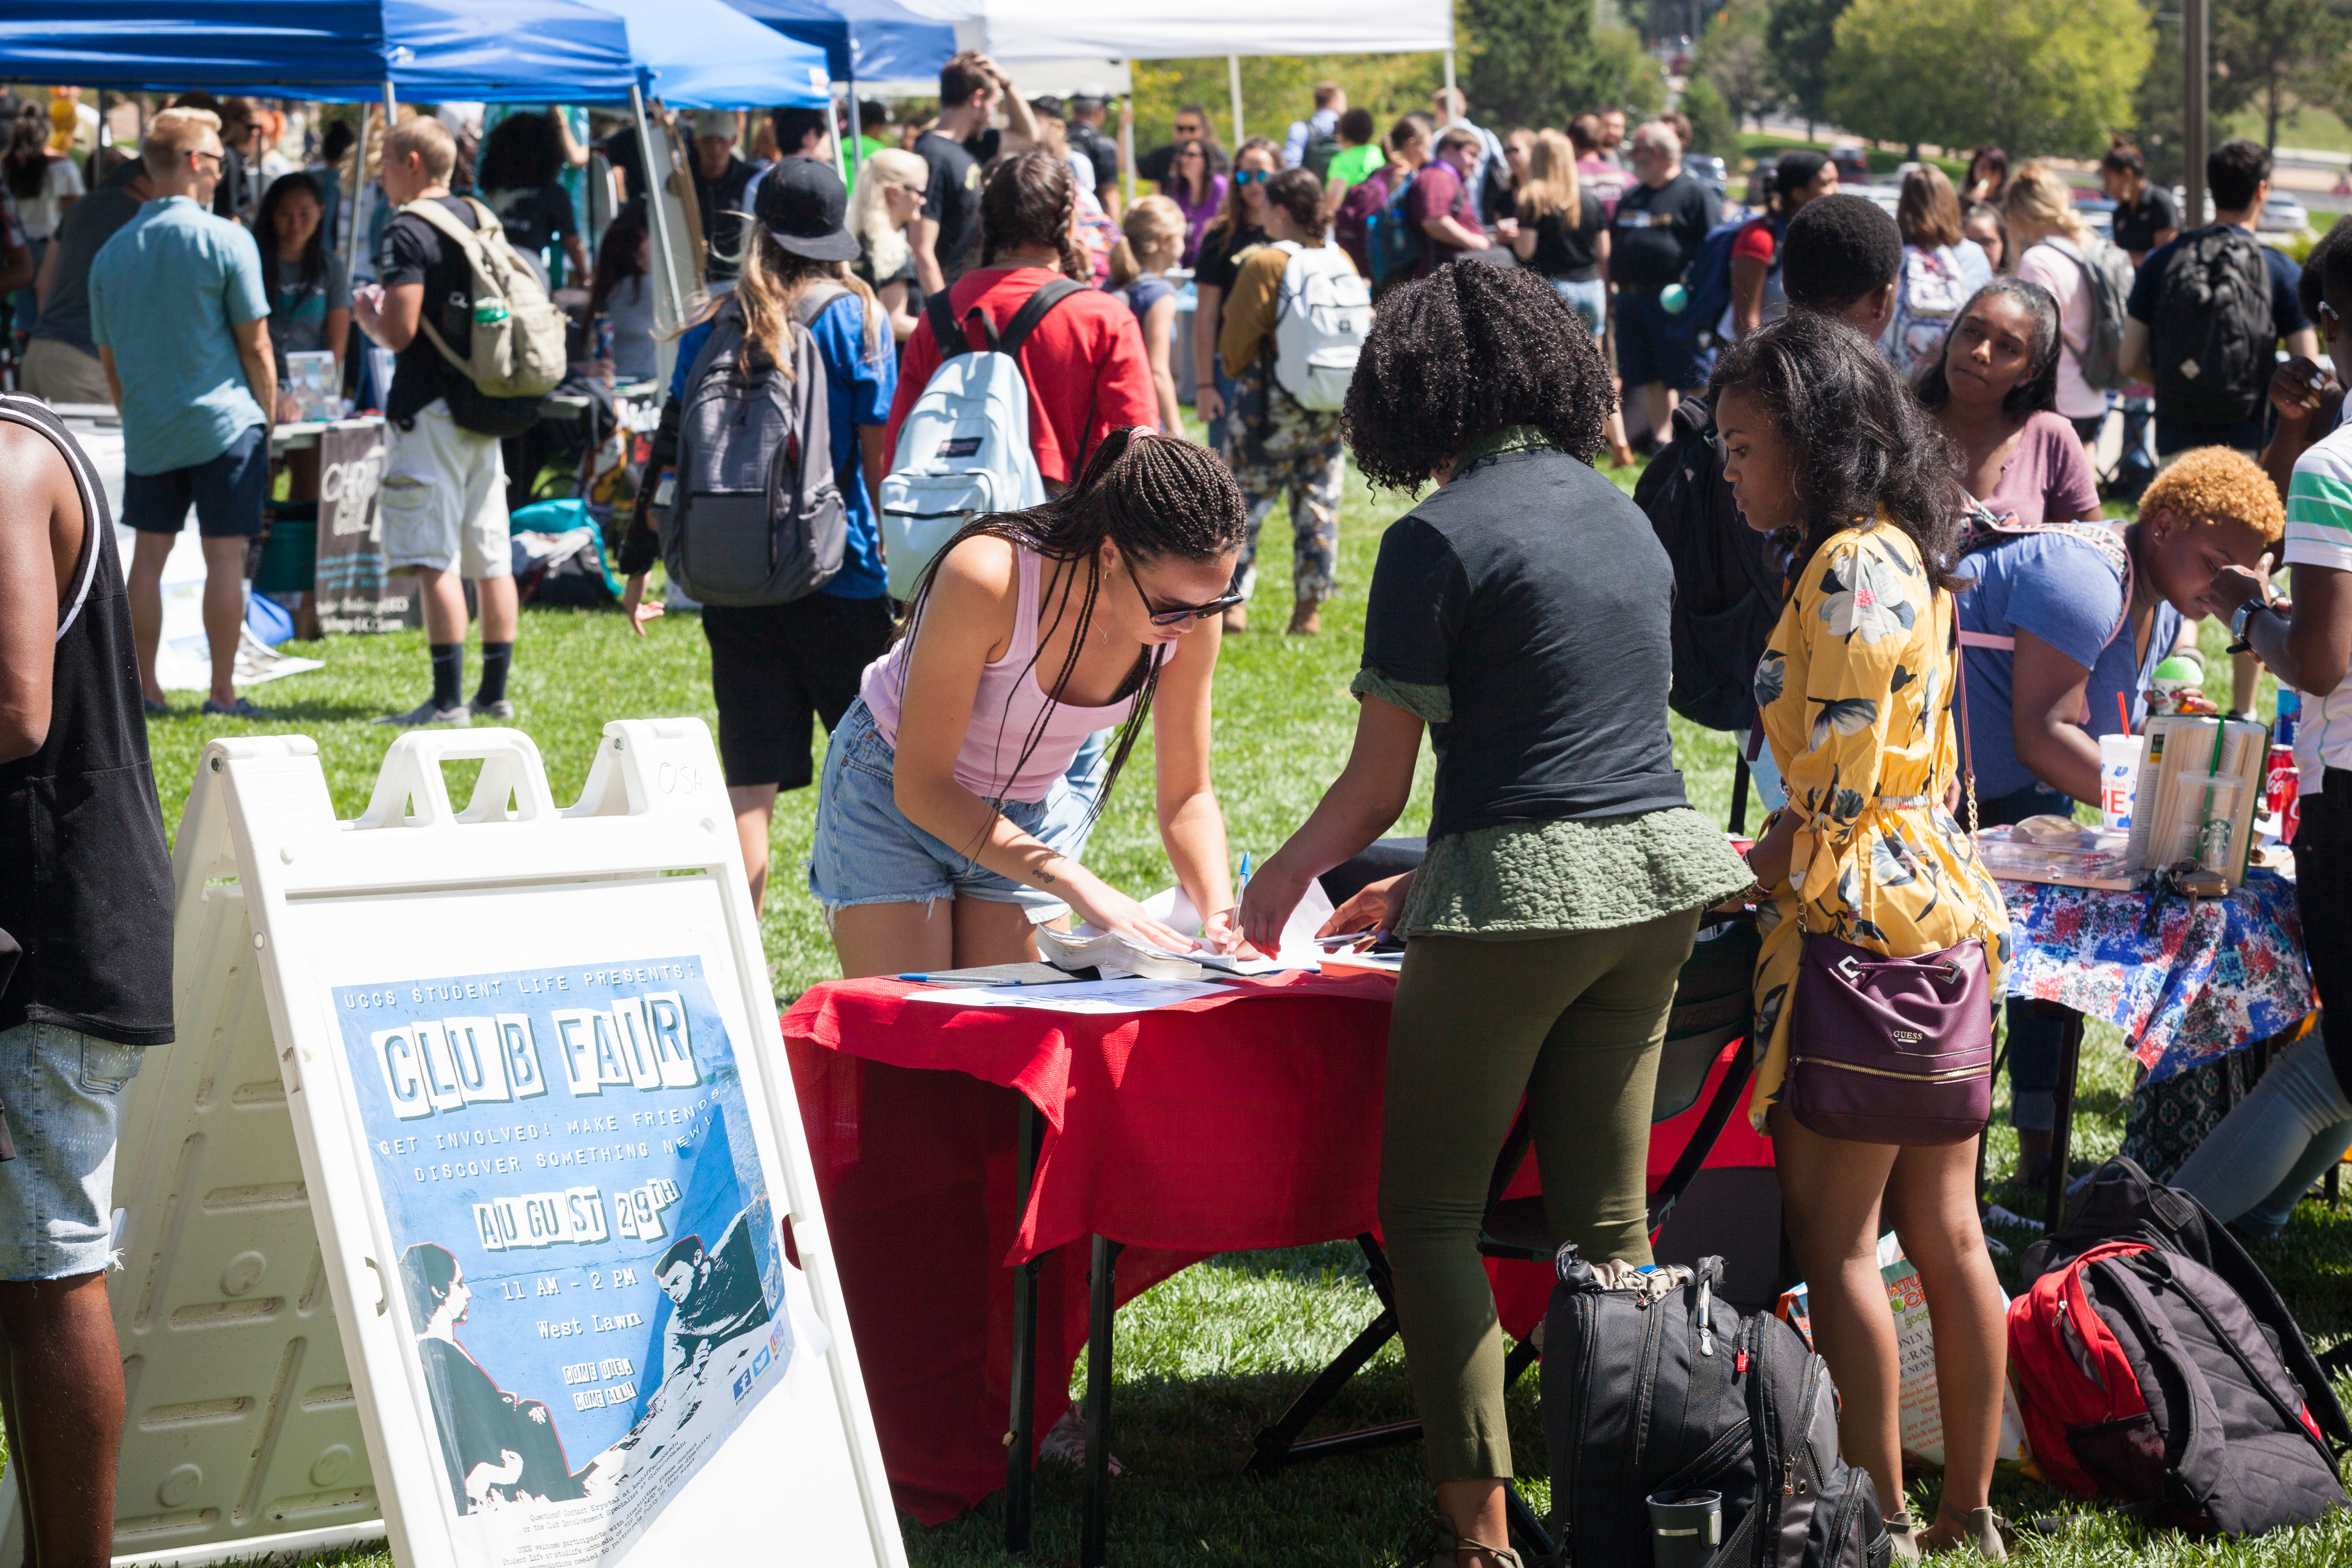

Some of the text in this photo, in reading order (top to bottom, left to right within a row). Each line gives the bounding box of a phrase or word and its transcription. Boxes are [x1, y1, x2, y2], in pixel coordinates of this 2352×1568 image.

[658, 762, 703, 794] OSA
[344, 963, 696, 1009] UCCS STUDENT LIFE PRESENTS:
[1893, 1030, 1922, 1040] GUESS
[383, 998, 691, 1104] CLUB FAIR
[379, 1136, 418, 1156] GET
[435, 1123, 551, 1150] INVOLVED!
[567, 1115, 619, 1135] MAKE
[414, 1116, 712, 1182] DISCOVER SOMETHING NEW!
[477, 1192, 605, 1247] AUGUST
[501, 1281, 527, 1301] 11
[537, 1277, 561, 1297] AM
[590, 1272, 604, 1290] 2
[611, 1268, 639, 1289] PM
[1884, 1273, 1922, 1297] ATU
[536, 1312, 645, 1339] West Lawn
[1905, 1307, 1930, 1329] good
[563, 1359, 632, 1383] COME ONE,
[1908, 1359, 1929, 1375] NEW
[575, 1382, 635, 1409] COME ALL!
[1909, 1378, 1920, 1387] are
[1925, 1381, 1938, 1392] and
[1901, 1400, 1917, 1410] food
[1921, 1404, 1936, 1415] that
[1906, 1429, 1927, 1442] which
[1907, 1423, 1918, 1431] are
[1919, 1416, 1934, 1427] now
[502, 1556, 527, 1566] Student
[529, 1552, 544, 1562] Life
[616, 1529, 623, 1537] or
[664, 1463, 684, 1484] discuss
[685, 1432, 713, 1464] disability
[517, 1545, 533, 1554] UCCS
[535, 1542, 560, 1551] welcomes
[562, 1530, 607, 1548] participants
[609, 1519, 624, 1532] with
[658, 1465, 676, 1484] Please
[677, 1442, 697, 1464] contact
[529, 1510, 561, 1522] Questions?
[563, 1508, 588, 1517] Contact
[590, 1496, 621, 1512] Krystal
[622, 1489, 631, 1498] at
[546, 1521, 560, 1529] Club
[562, 1513, 604, 1527] Involvement
[606, 1491, 639, 1516] Specialist
[640, 1482, 647, 1490] at
[575, 1552, 599, 1565] needed
[612, 1515, 643, 1549] participate
[643, 1497, 658, 1515] fully
[660, 1488, 666, 1497] in
[667, 1474, 679, 1488] this
